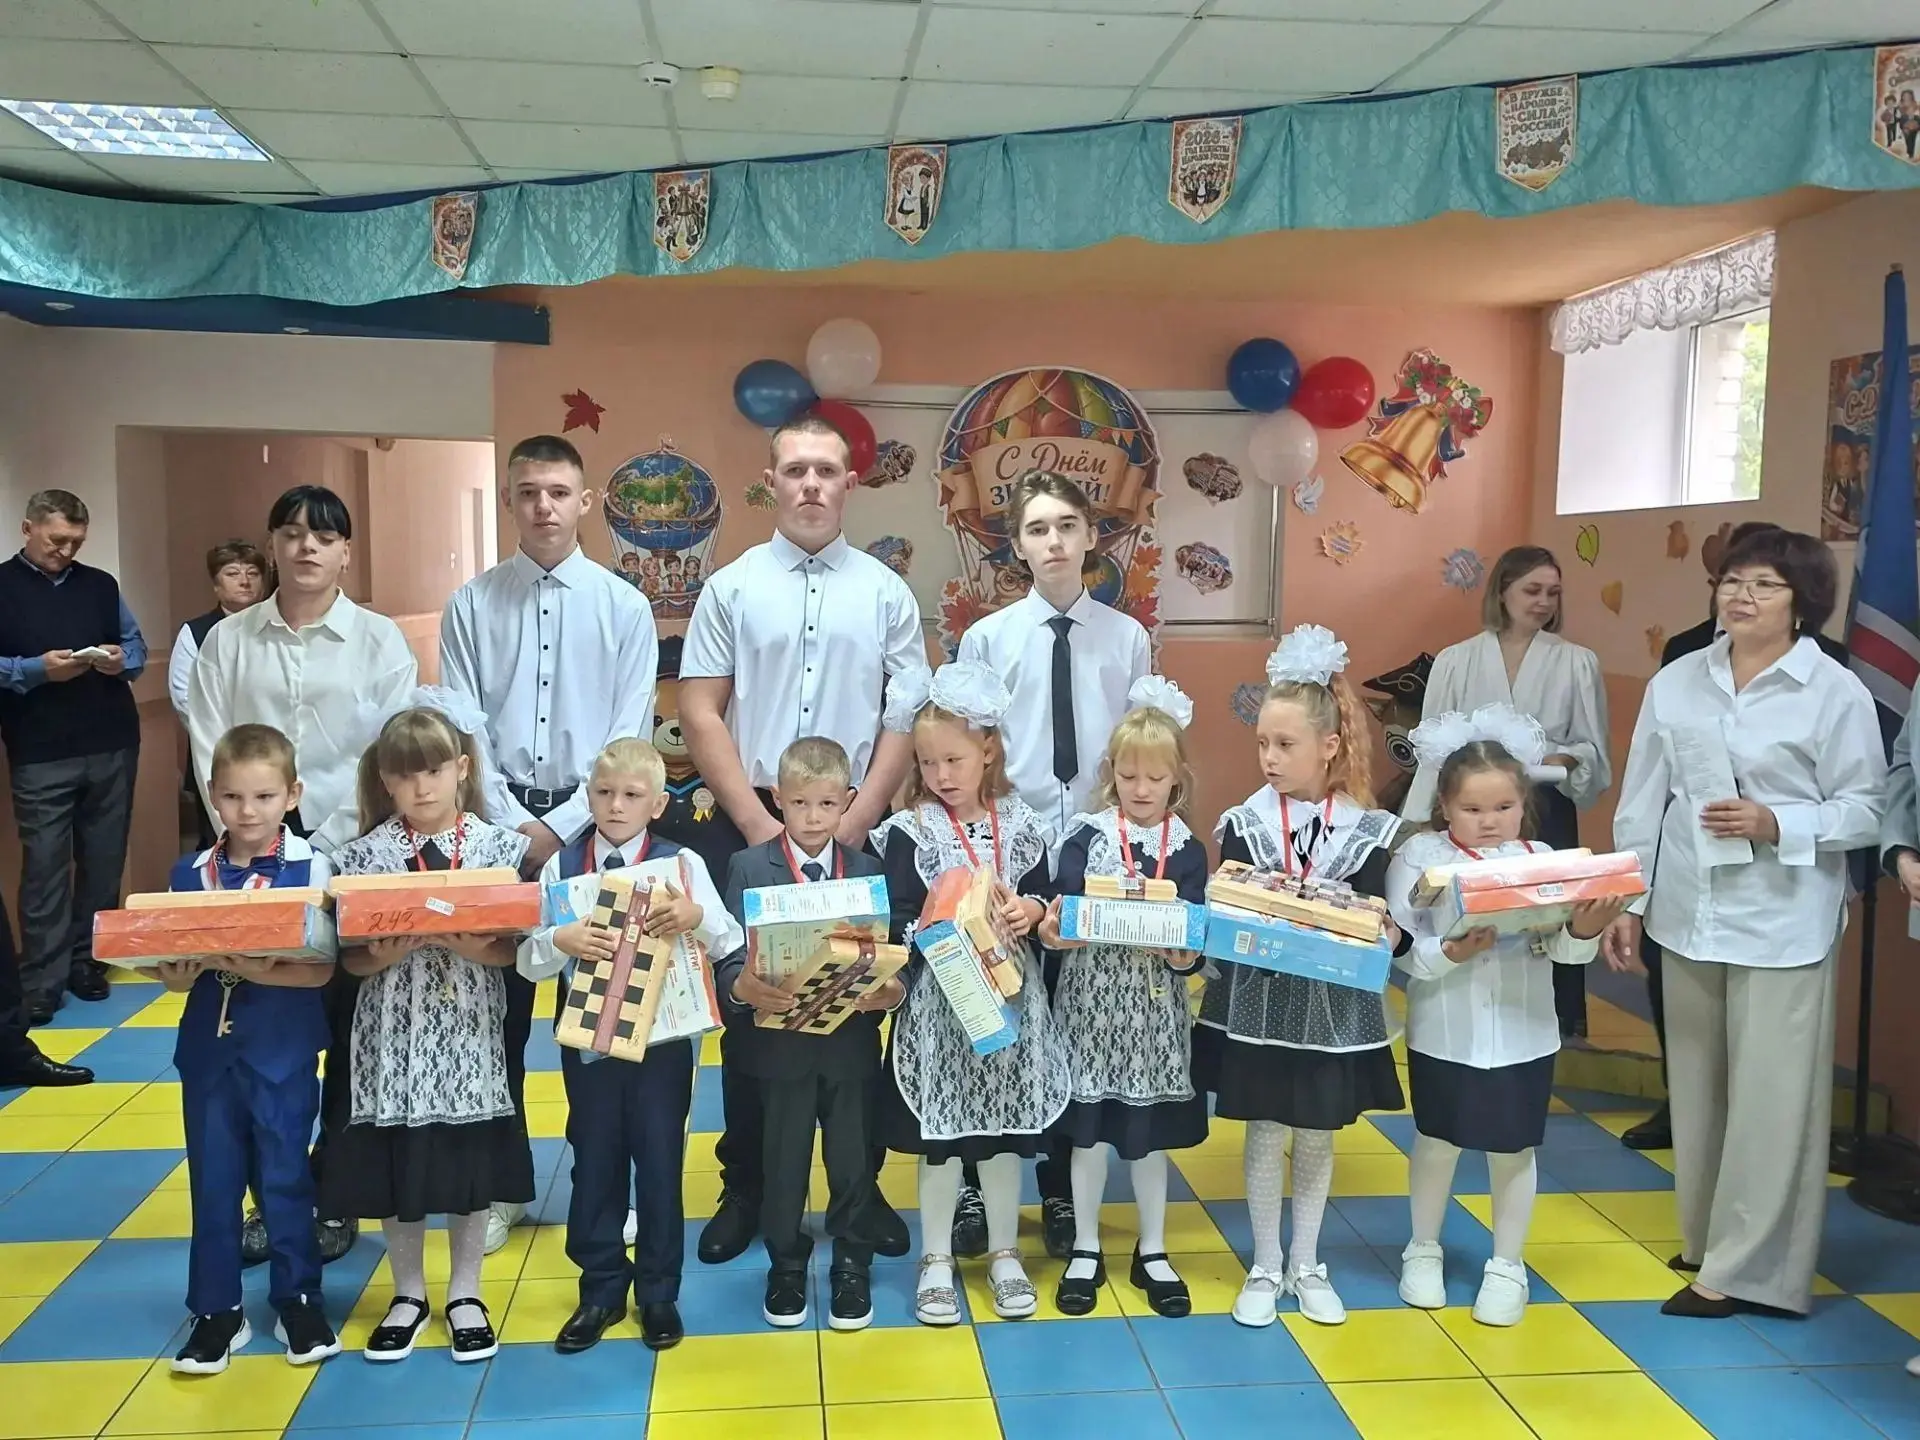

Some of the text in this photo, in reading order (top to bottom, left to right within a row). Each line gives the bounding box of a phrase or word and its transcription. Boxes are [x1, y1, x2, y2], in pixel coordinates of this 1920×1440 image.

[1517, 108, 1558, 122] СИЛА
[995, 442, 1108, 480] С Днём
[367, 911, 415, 932] 243
